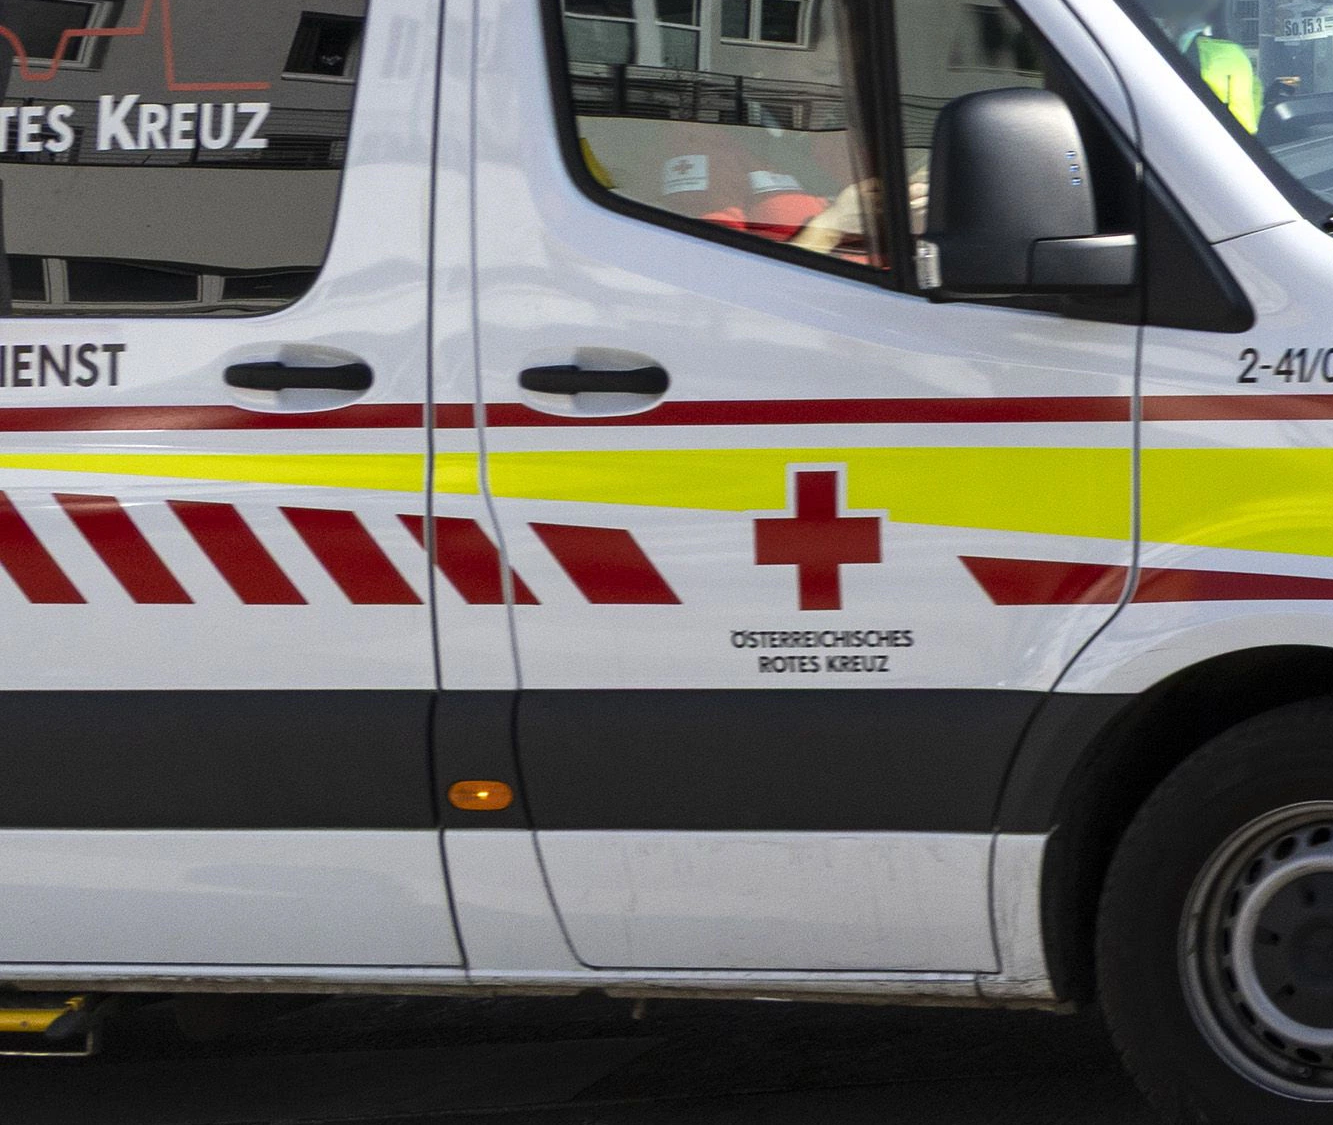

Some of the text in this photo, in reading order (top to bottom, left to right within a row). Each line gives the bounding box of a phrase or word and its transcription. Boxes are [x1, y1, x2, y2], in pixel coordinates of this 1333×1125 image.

[97, 94, 271, 151] KREUZ
[730, 629, 914, 648] ÖSTERREICHISCHES
[758, 655, 890, 673] ROTES KREUZ
